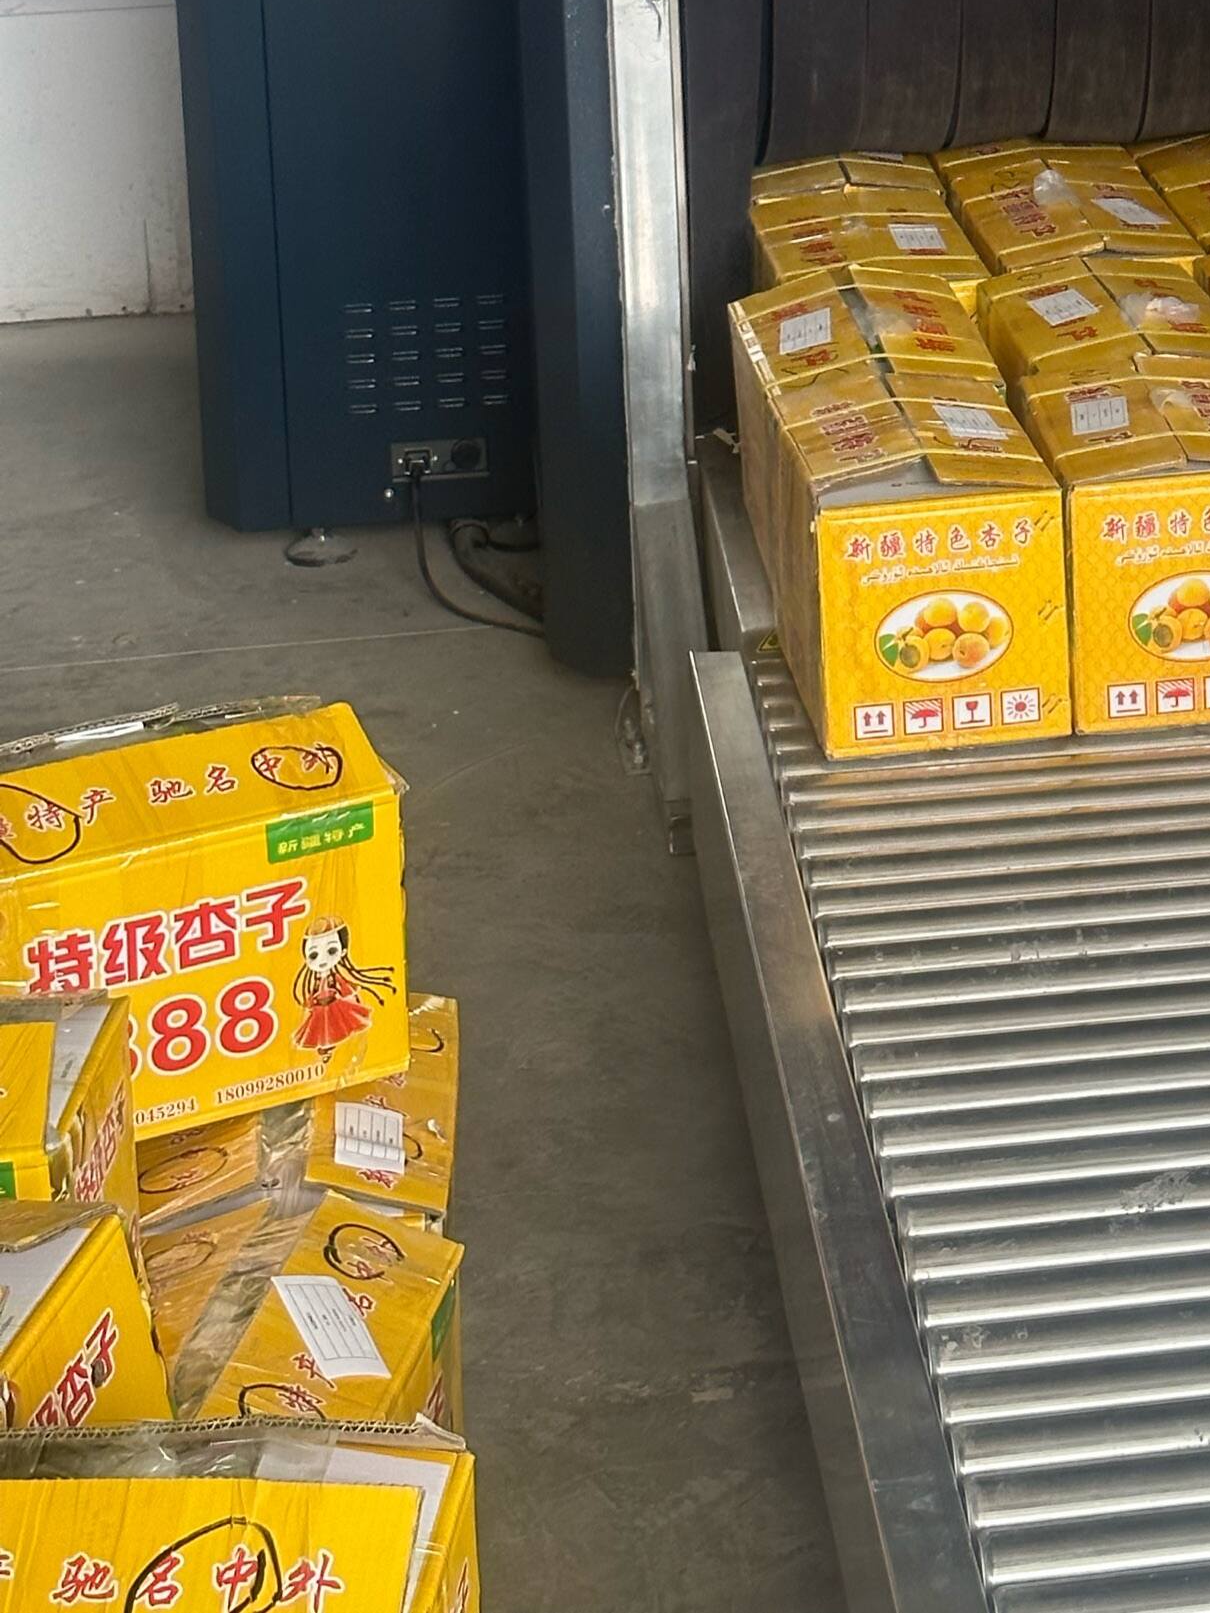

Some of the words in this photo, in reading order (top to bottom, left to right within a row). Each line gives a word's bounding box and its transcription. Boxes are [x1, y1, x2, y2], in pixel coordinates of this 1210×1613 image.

[847, 519, 1033, 560] 新疆特色杏子
[278, 823, 364, 855] 新疆特产
[27, 880, 307, 992] 特级杏子
[128, 977, 276, 1077] 88
[216, 1064, 325, 1104] 18099280010
[53, 1547, 342, 1613] 驰名中外
